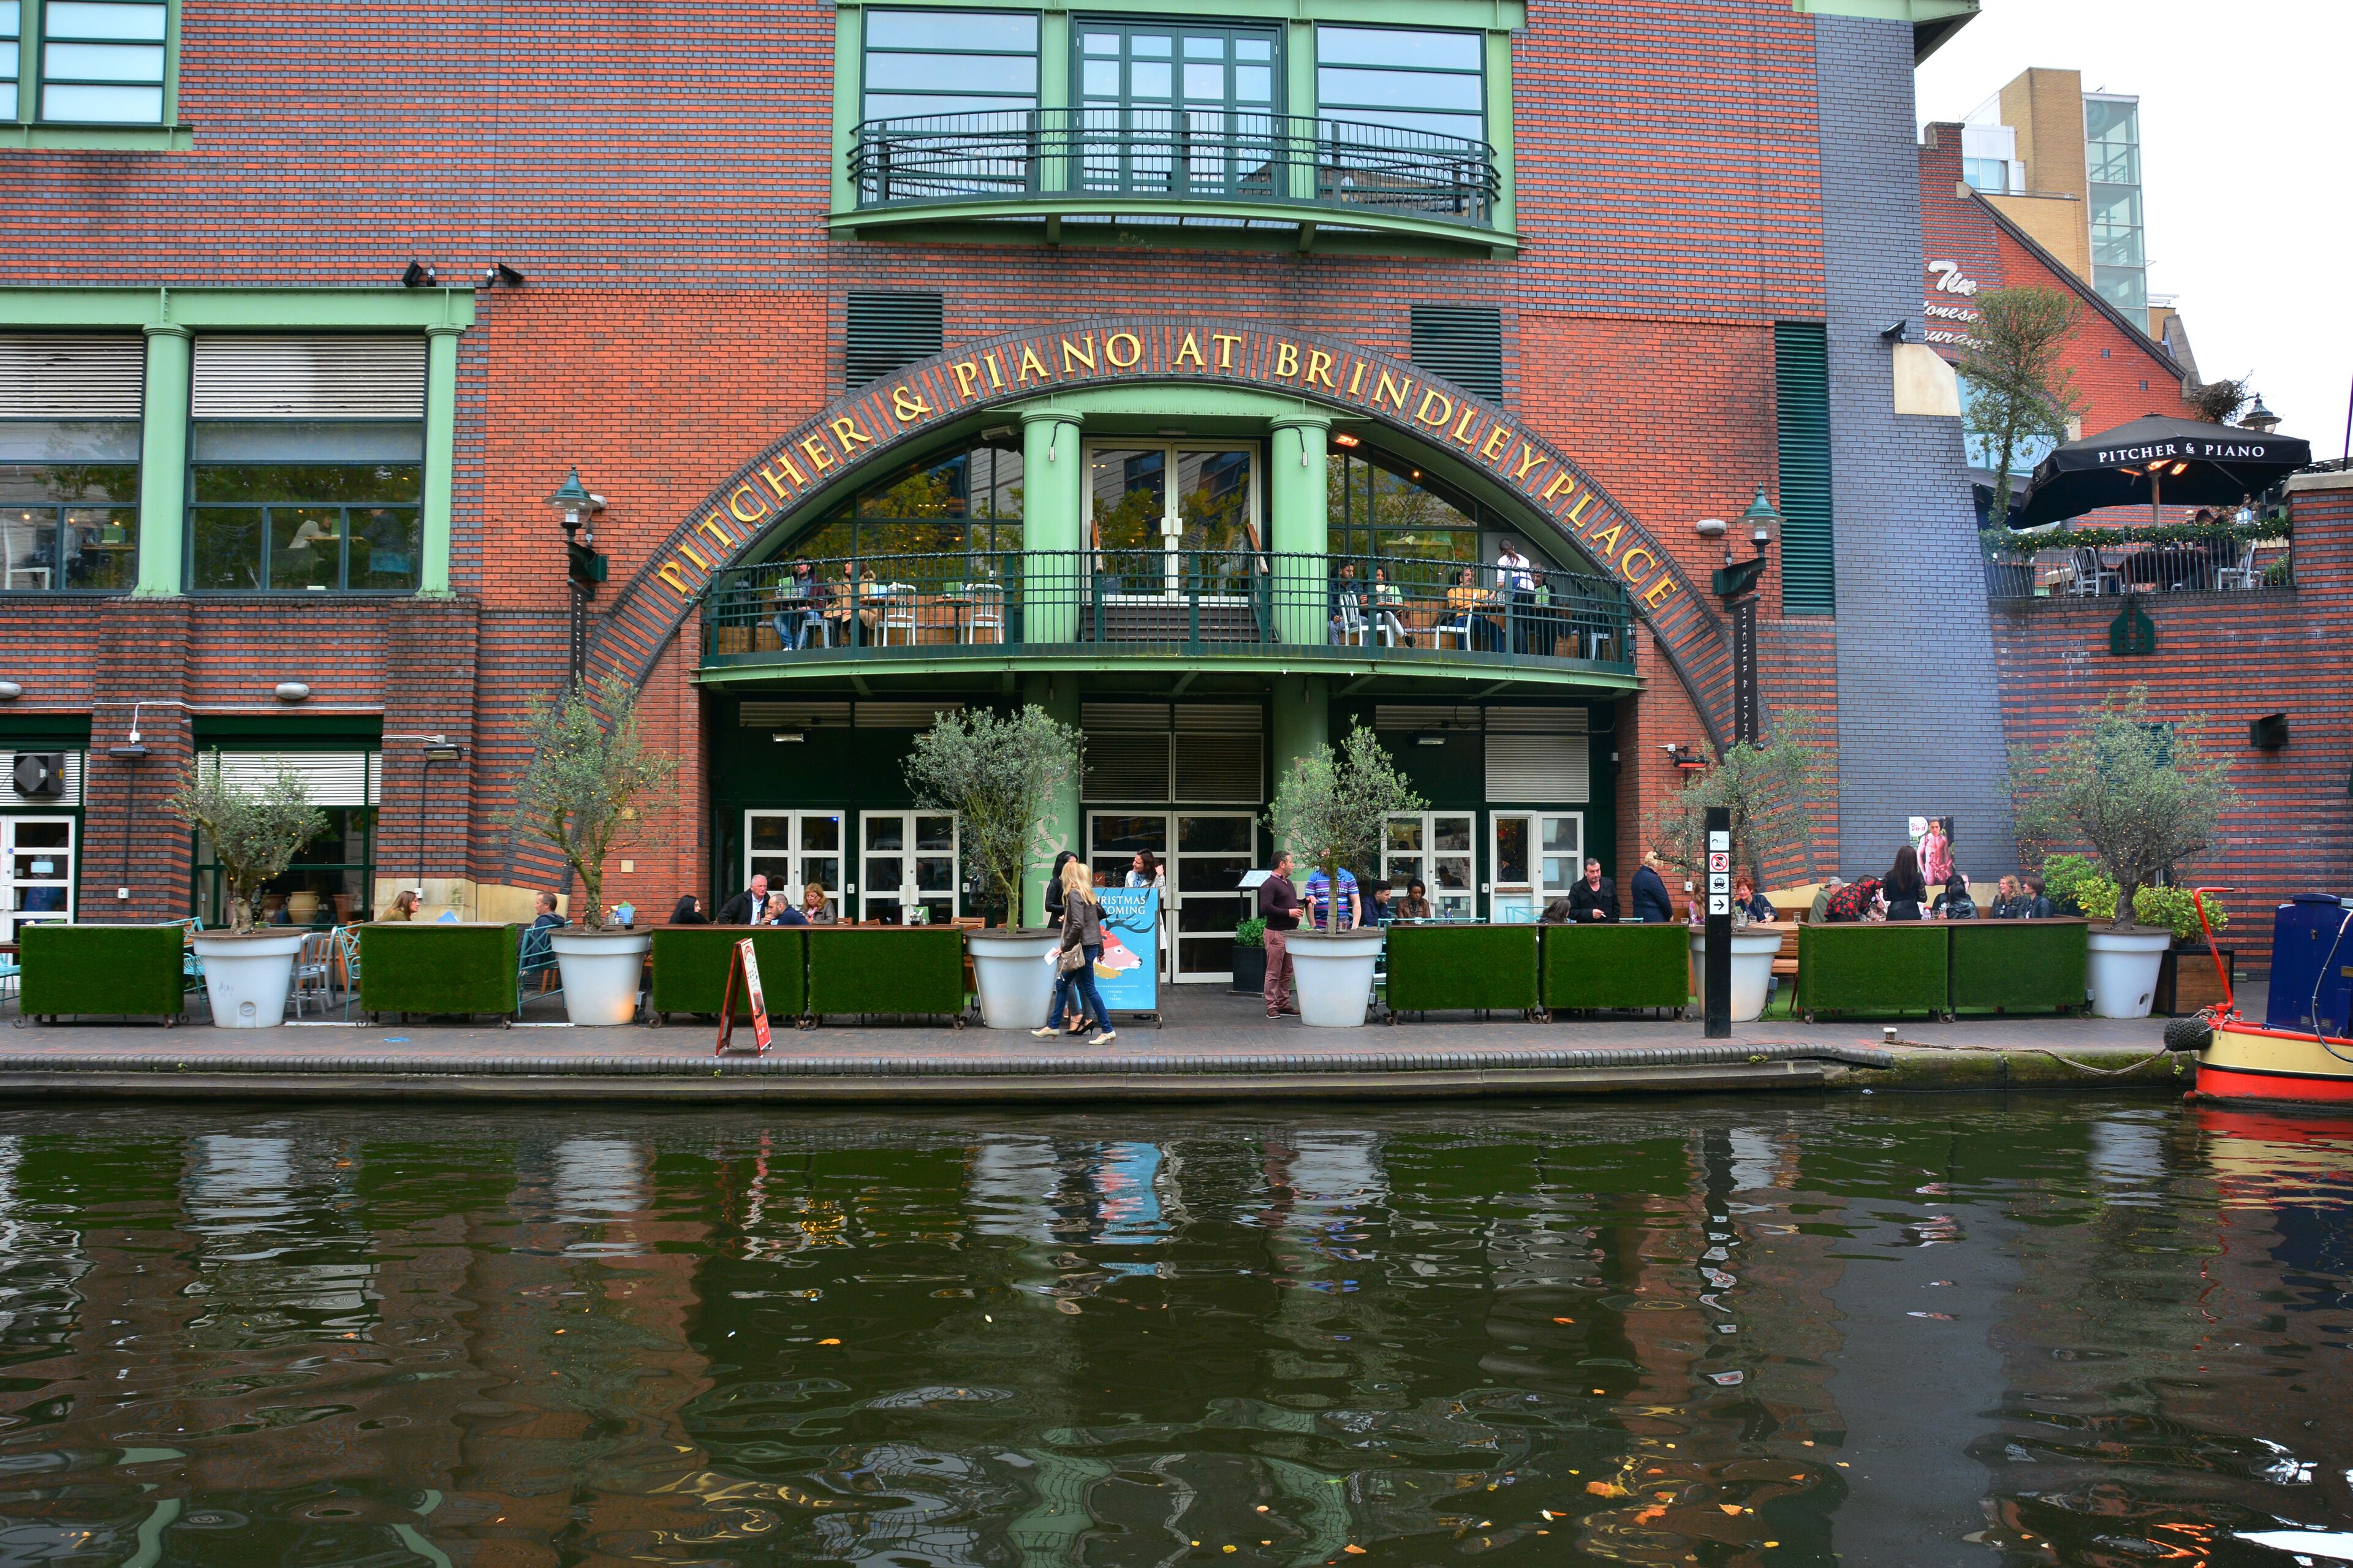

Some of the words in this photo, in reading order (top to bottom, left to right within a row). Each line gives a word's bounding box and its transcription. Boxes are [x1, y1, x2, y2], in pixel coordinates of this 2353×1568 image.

[2098, 443, 2178, 463] PITCHER
[2185, 442, 2195, 454] &
[2205, 444, 2265, 457] PIANO
[656, 417, 874, 596] PITCHER
[892, 385, 933, 422] &
[951, 332, 1142, 398] PIANO
[1173, 331, 1243, 369] AT
[1911, 823, 1927, 831] Bird
